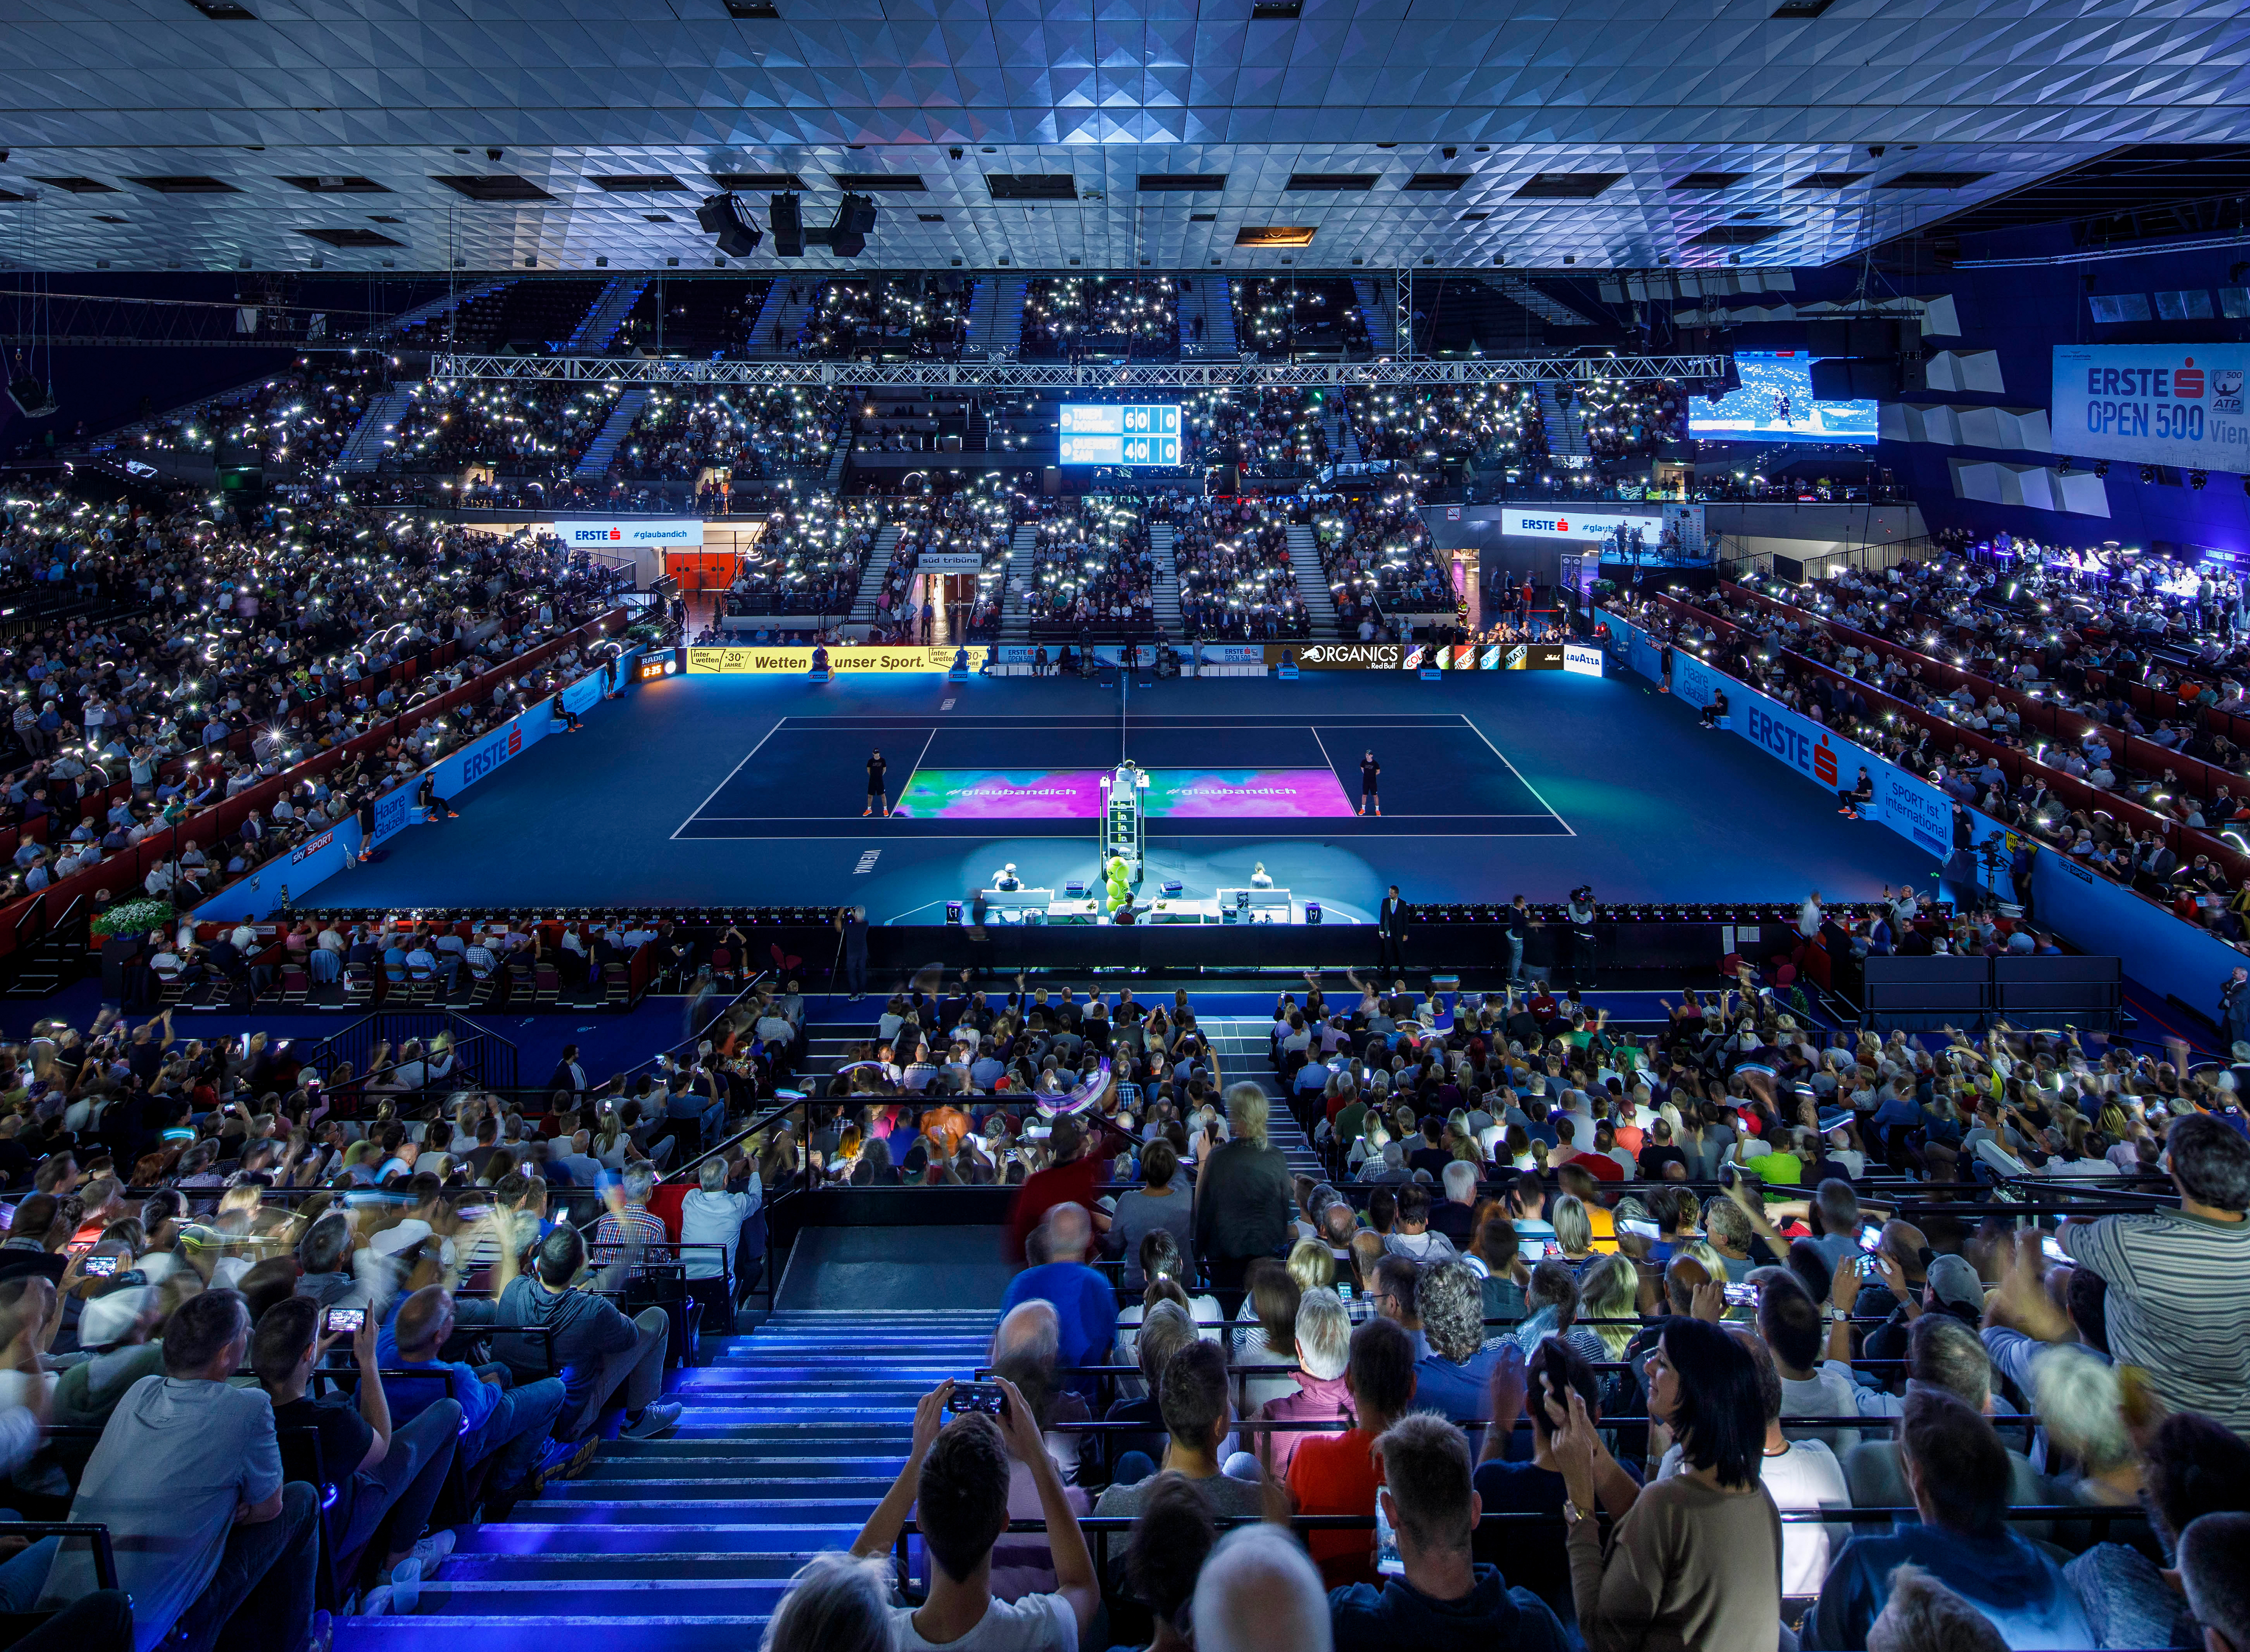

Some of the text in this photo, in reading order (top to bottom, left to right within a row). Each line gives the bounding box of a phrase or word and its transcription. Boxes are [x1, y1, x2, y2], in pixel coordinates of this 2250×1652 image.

[2088, 368, 2168, 397] ERSTE
[2214, 399, 2241, 408] ATP
[1125, 413, 1175, 428] 6 0 0
[2088, 400, 2203, 441] OPEN 500
[1125, 443, 1174, 458] 4 0 0
[576, 530, 687, 540] ERSTE #glaubandich
[1522, 520, 1555, 531] ERSTE
[1652, 641, 1662, 651] SPOR
[642, 655, 663, 664] RADO
[728, 653, 740, 661] 30
[755, 656, 806, 668] Wetten
[834, 658, 876, 668] unser
[880, 655, 924, 670] Sport.
[1507, 647, 1525, 666] MATE
[1566, 654, 1600, 666] LAVAZZA
[644, 665, 661, 677] 0:35
[1684, 660, 1708, 689] Haare
[1684, 680, 1704, 705] Glatze
[1749, 705, 1809, 771] ERSTE
[464, 737, 506, 785] ERSTE
[946, 788, 1077, 797] #glaubandich
[1166, 788, 1296, 796] #glaubandich
[1892, 782, 1939, 819] SPORT ist
[375, 795, 405, 823] Haare
[1886, 793, 1947, 839] international
[375, 816, 400, 839] Glatze
[293, 833, 332, 862] sky SPORT
[1914, 832, 1940, 852] INTEGRATION
[853, 850, 882, 874] VIENNA
[2060, 861, 2091, 882] sky SPORT
